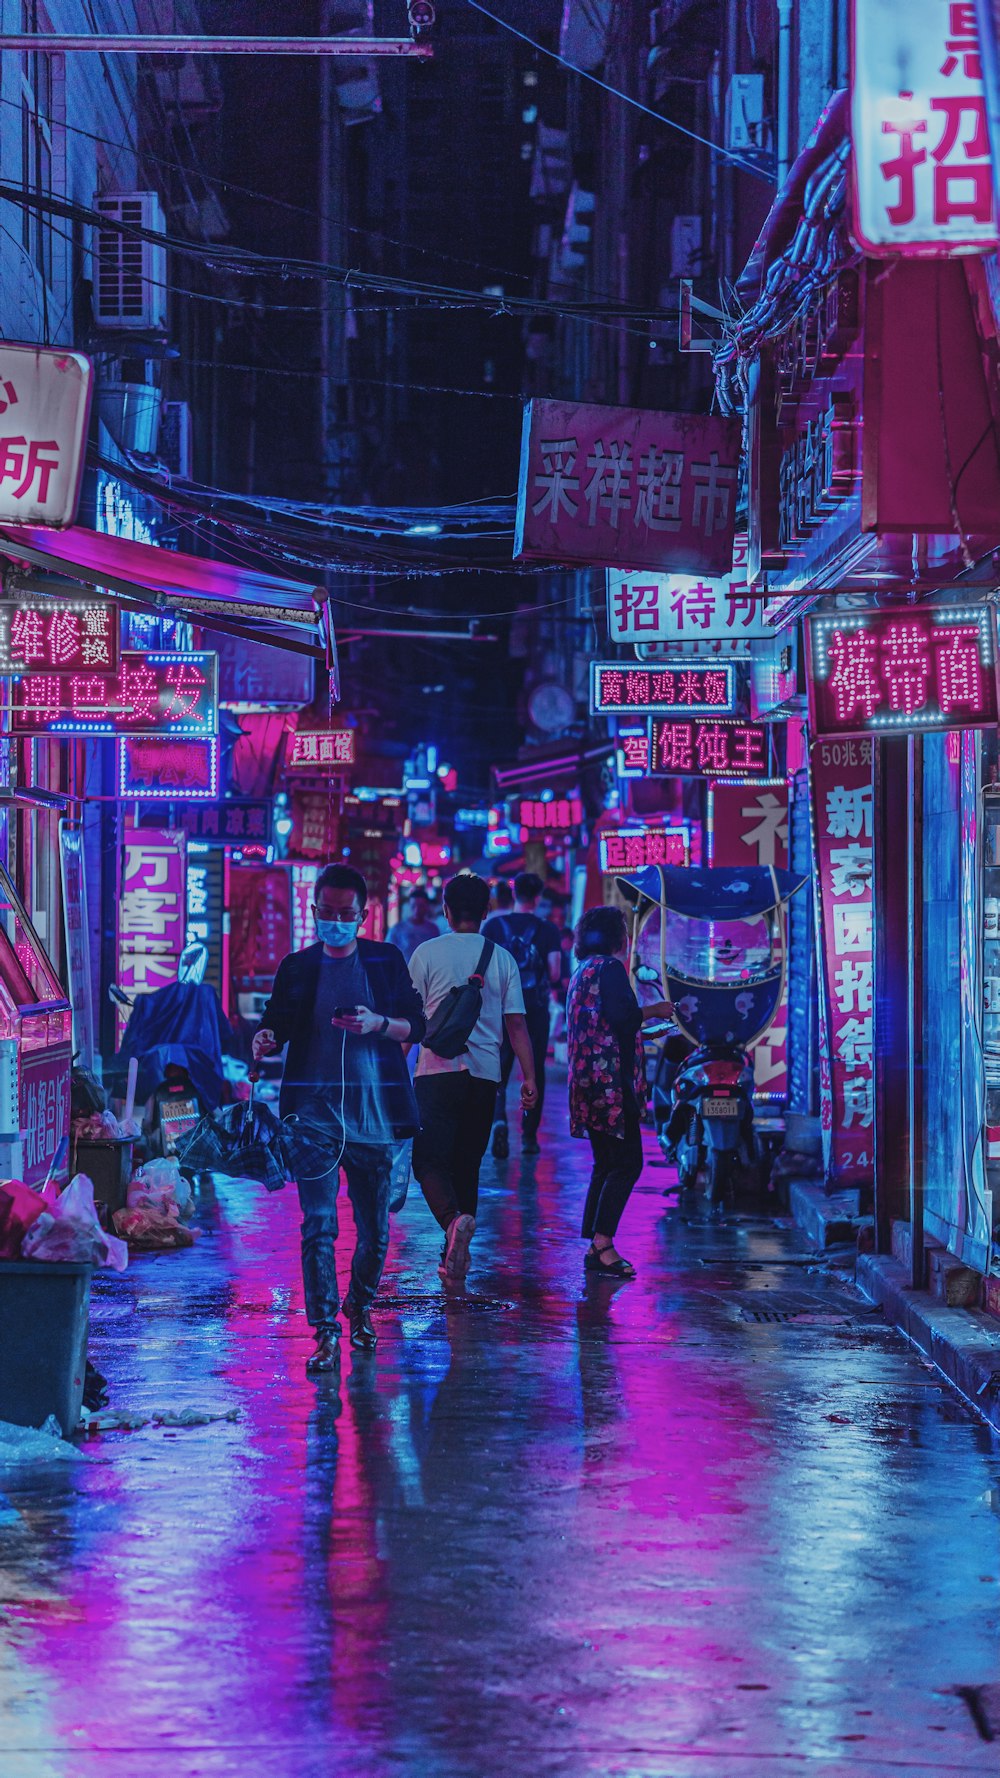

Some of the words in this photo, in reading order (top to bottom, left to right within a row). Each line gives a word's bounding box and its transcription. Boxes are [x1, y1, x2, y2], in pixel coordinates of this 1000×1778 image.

[880, 90, 993, 225] 招
[0, 436, 60, 504] 所
[532, 437, 737, 537] 采祥超市
[11, 609, 80, 664] 维修
[614, 581, 763, 633] 招待所
[601, 670, 726, 706] 黄焖鸡米饭
[828, 625, 980, 718] 裤带面
[659, 722, 764, 769] 馄饨王
[118, 844, 181, 995] 万客来
